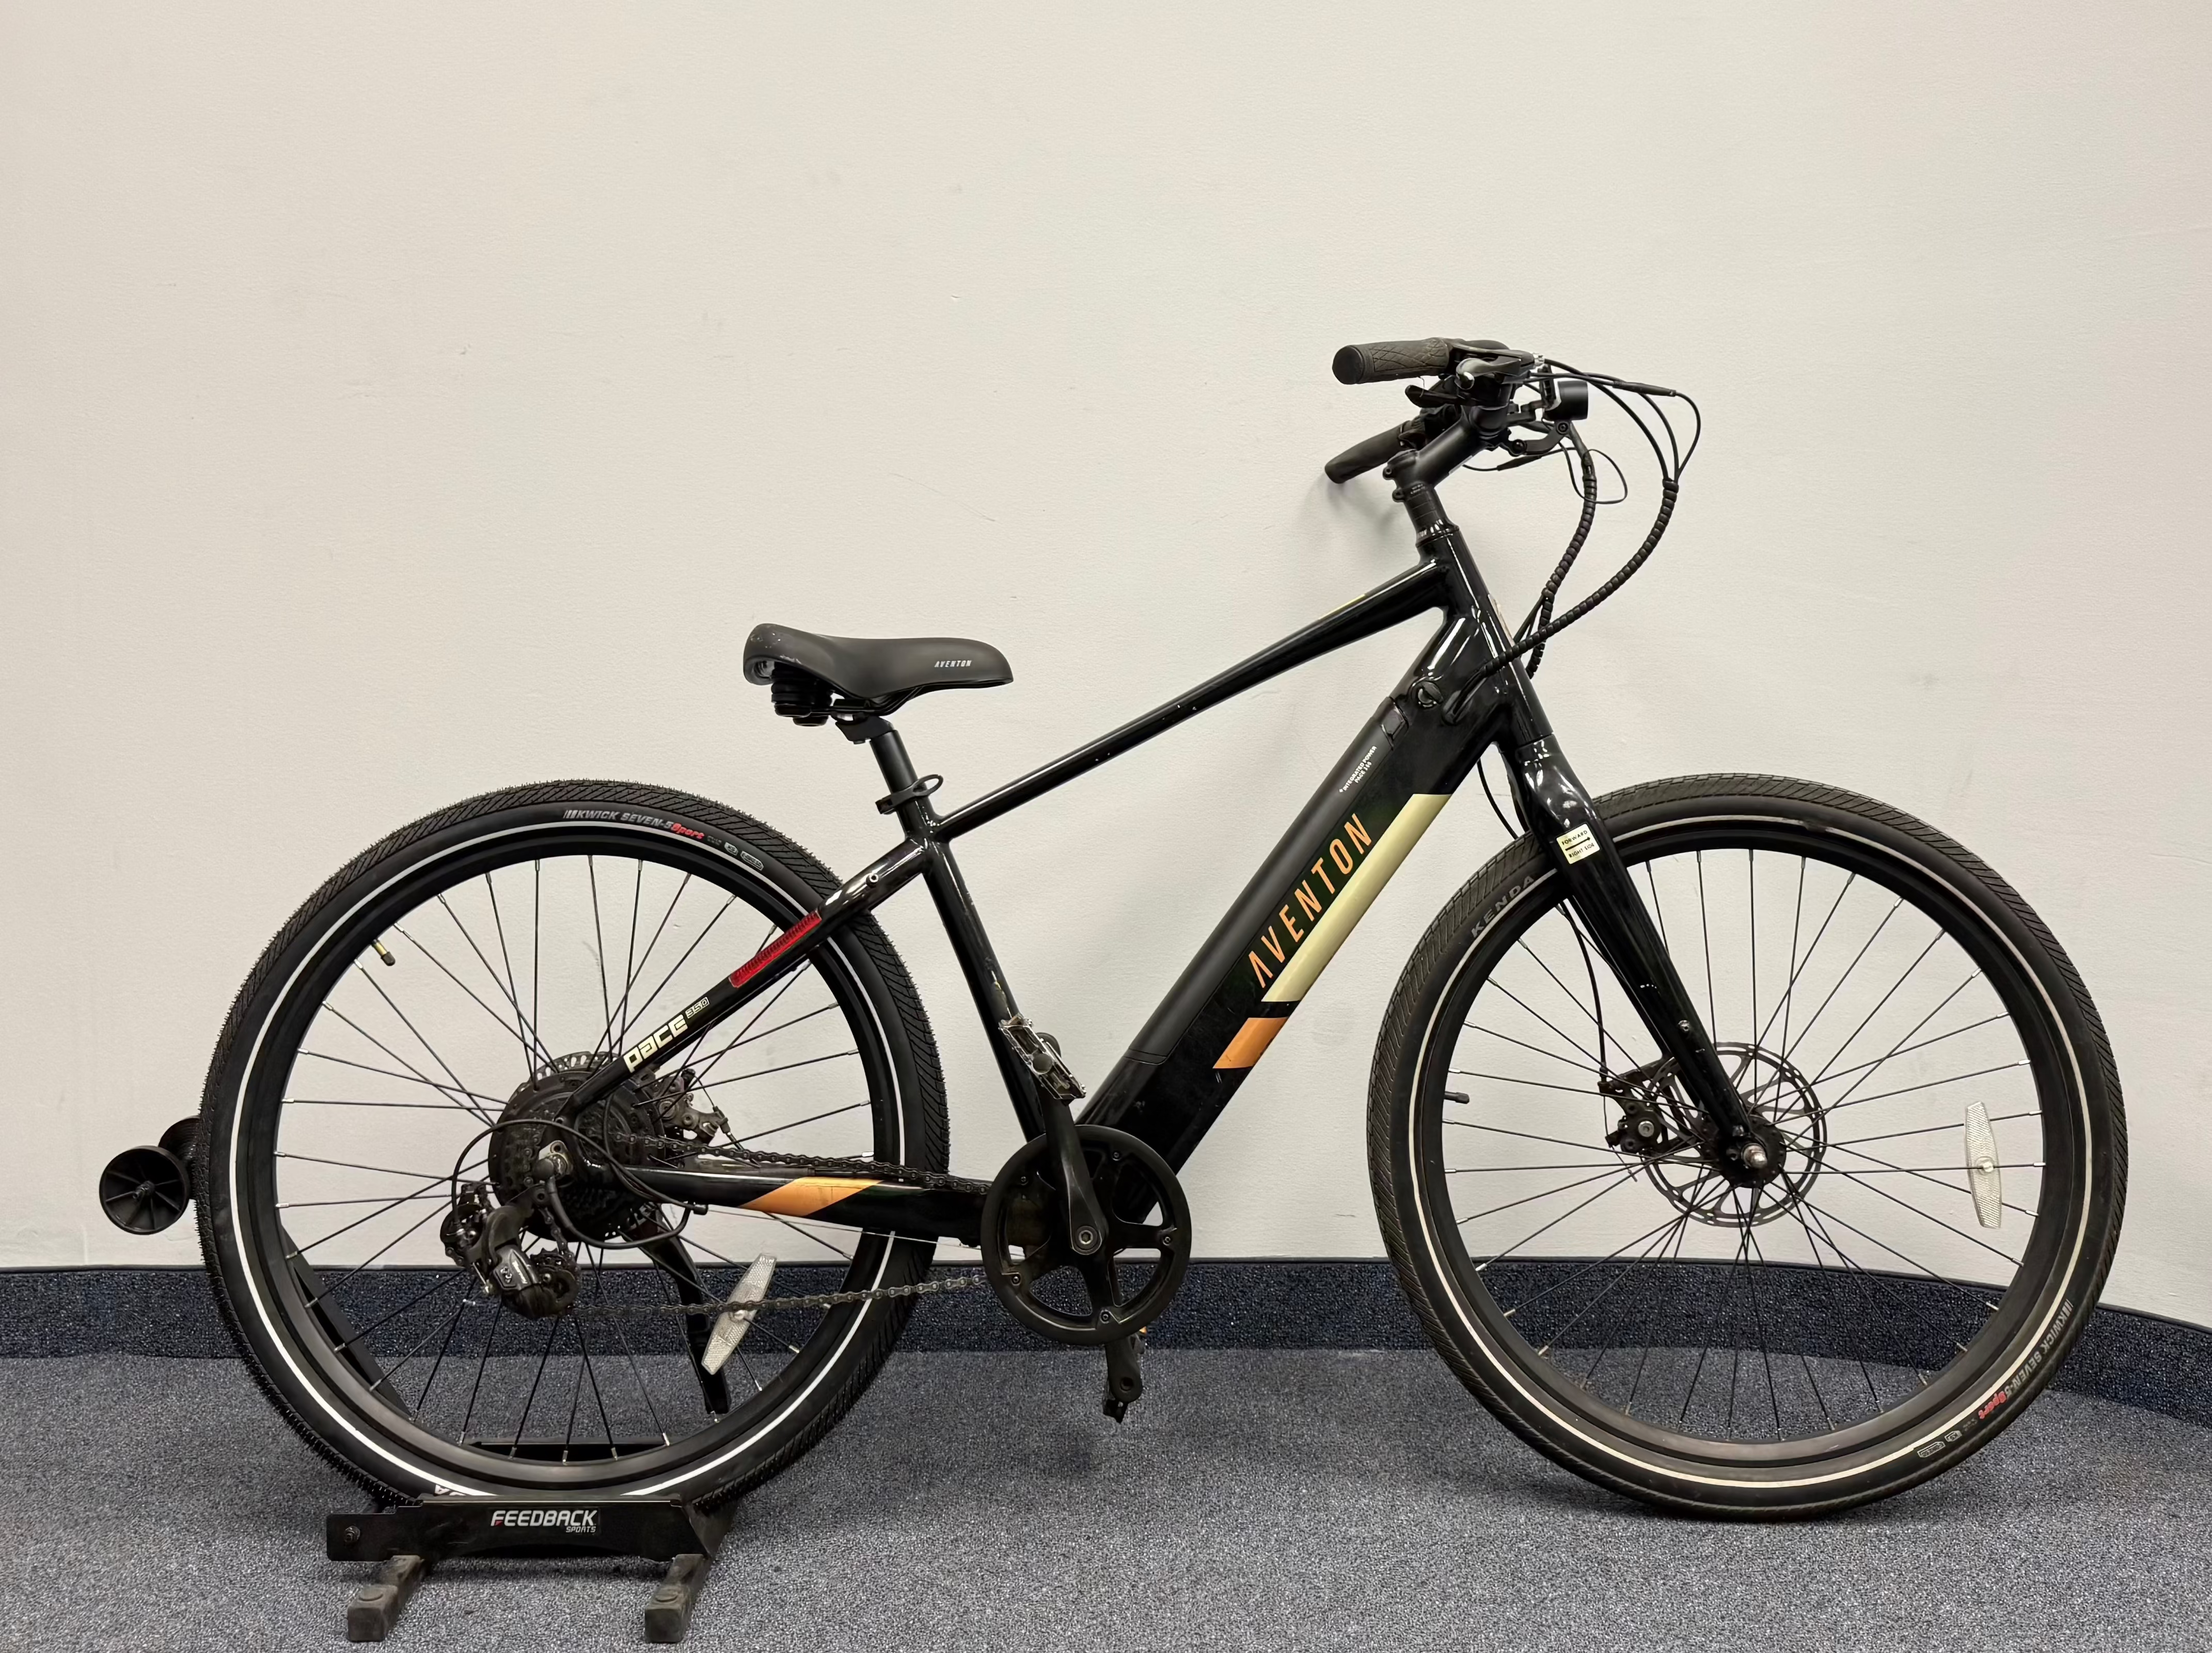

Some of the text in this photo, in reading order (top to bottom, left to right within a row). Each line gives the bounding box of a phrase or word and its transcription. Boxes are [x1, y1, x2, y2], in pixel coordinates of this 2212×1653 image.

[576, 810, 620, 820] KWICK
[1561, 830, 1588, 845] FORWARD
[1568, 848, 1584, 858] RIGHT
[1248, 813, 1372, 988] AVENTON
[1471, 875, 1534, 938] KENDA
[2041, 1314, 2068, 1353] KWICK
[490, 1509, 597, 1526] FEEDBACK
